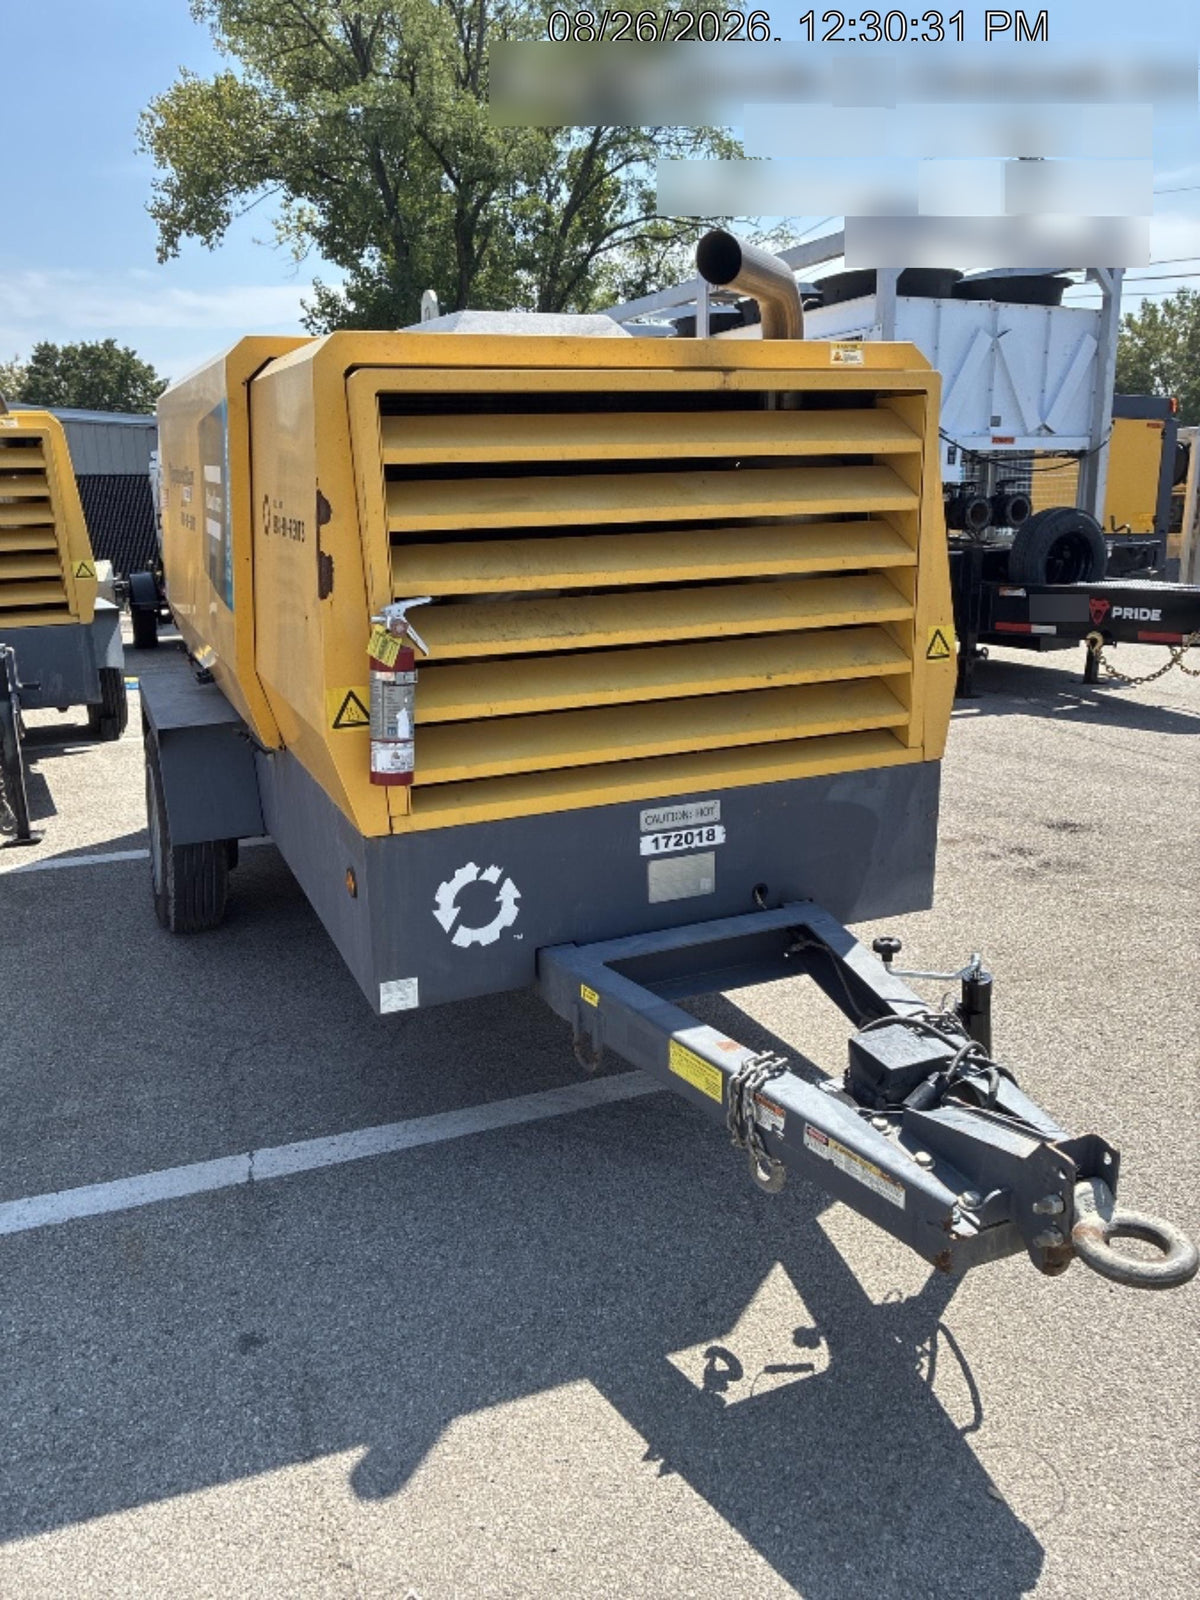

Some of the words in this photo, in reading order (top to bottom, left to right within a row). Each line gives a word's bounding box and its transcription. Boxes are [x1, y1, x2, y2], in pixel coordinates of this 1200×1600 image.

[1111, 606, 1162, 621] PRIDE
[644, 809, 692, 825] CAUTION:
[696, 806, 715, 817] HOT
[651, 828, 716, 850] 172018
